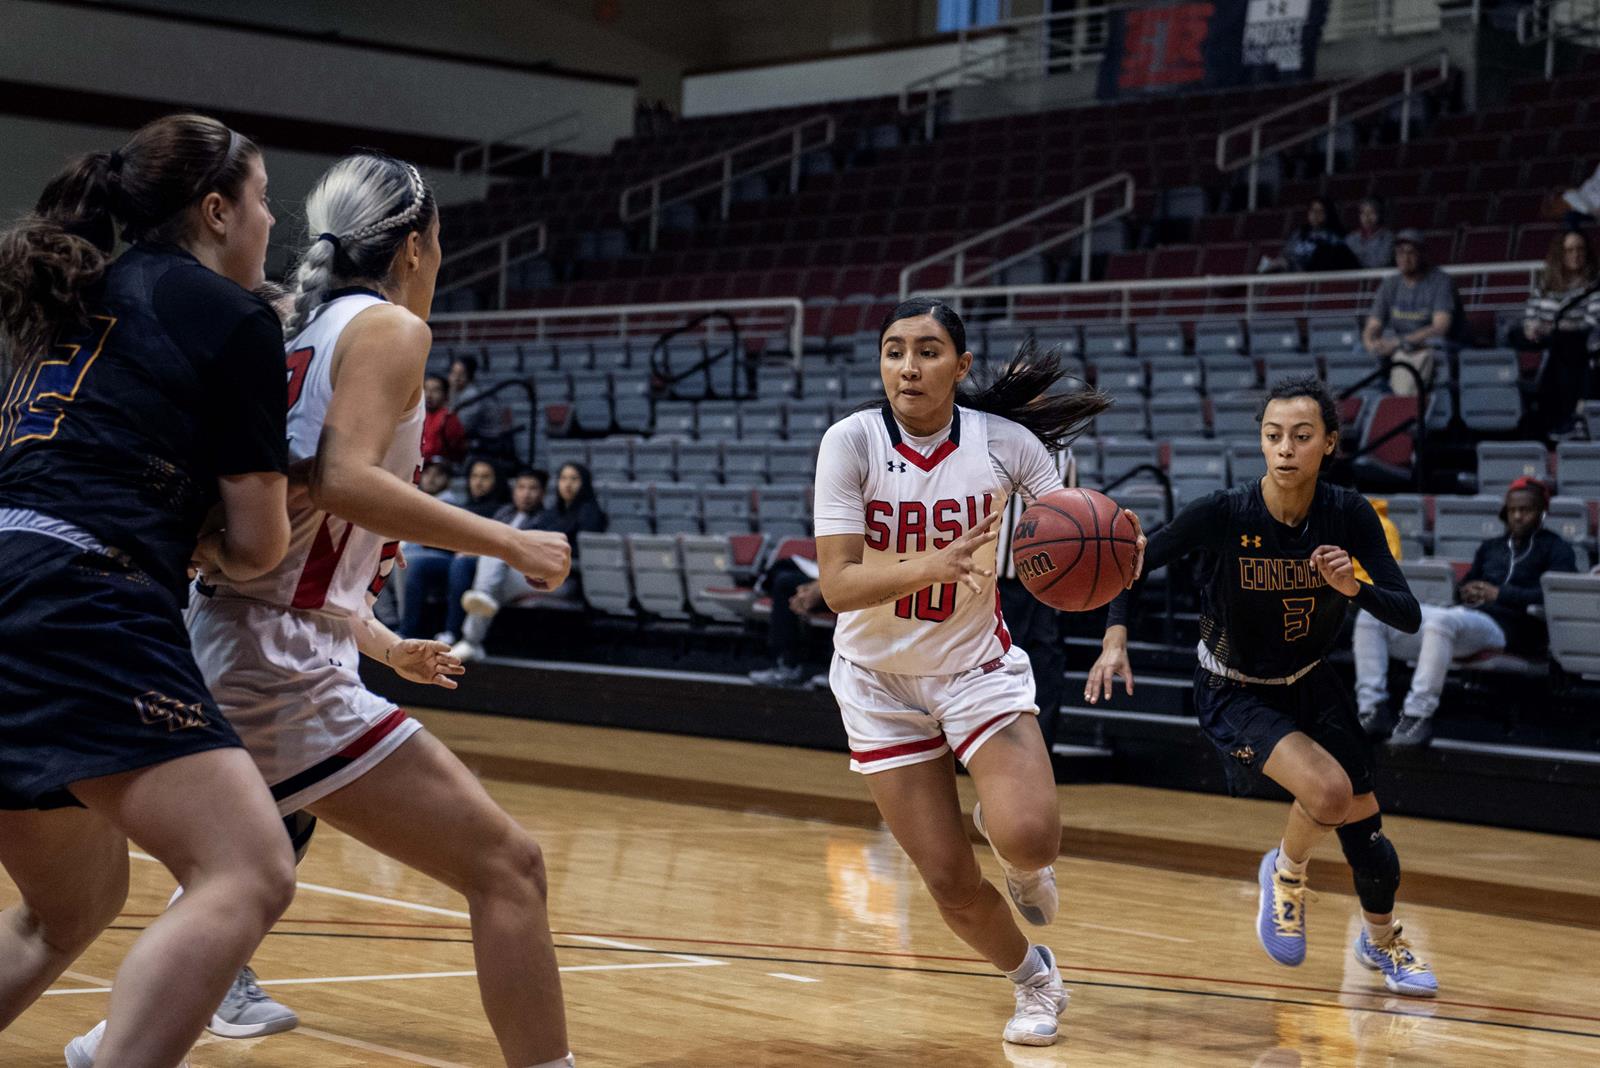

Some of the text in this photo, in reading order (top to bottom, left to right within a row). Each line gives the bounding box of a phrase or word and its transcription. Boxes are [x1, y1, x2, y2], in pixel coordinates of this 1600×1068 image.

[864, 493, 993, 554] SASU
[1238, 556, 1329, 591] CONCOR
[1282, 596, 1315, 642] 3
[1282, 901, 1296, 921] 2
